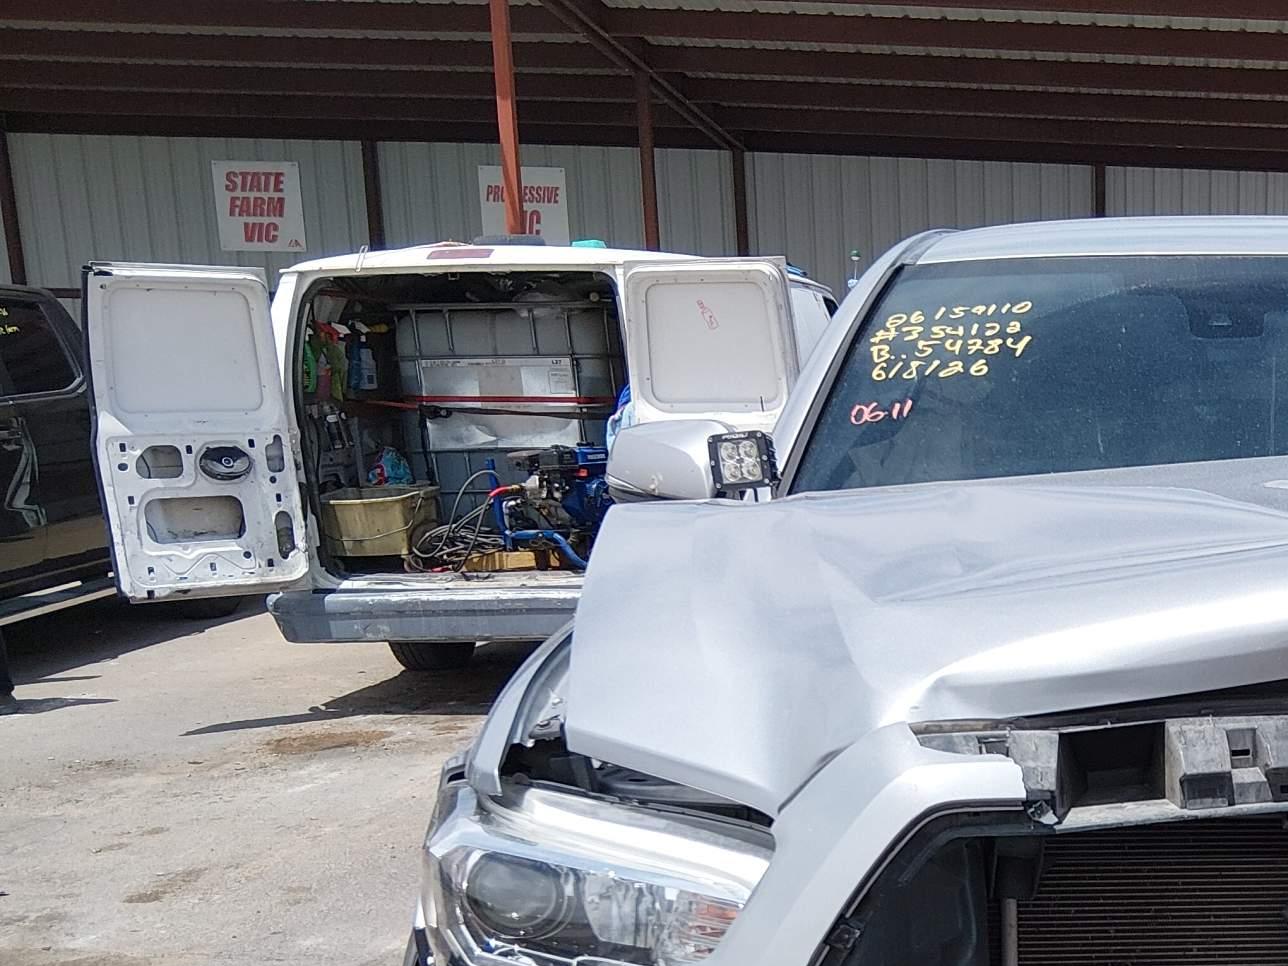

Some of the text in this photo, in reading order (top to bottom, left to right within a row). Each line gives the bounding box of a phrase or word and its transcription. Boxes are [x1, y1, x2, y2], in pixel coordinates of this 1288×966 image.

[225, 170, 285, 193] STATE
[486, 185, 561, 204] PRESSIVE
[229, 196, 286, 218] FARM
[243, 221, 279, 243] VIC
